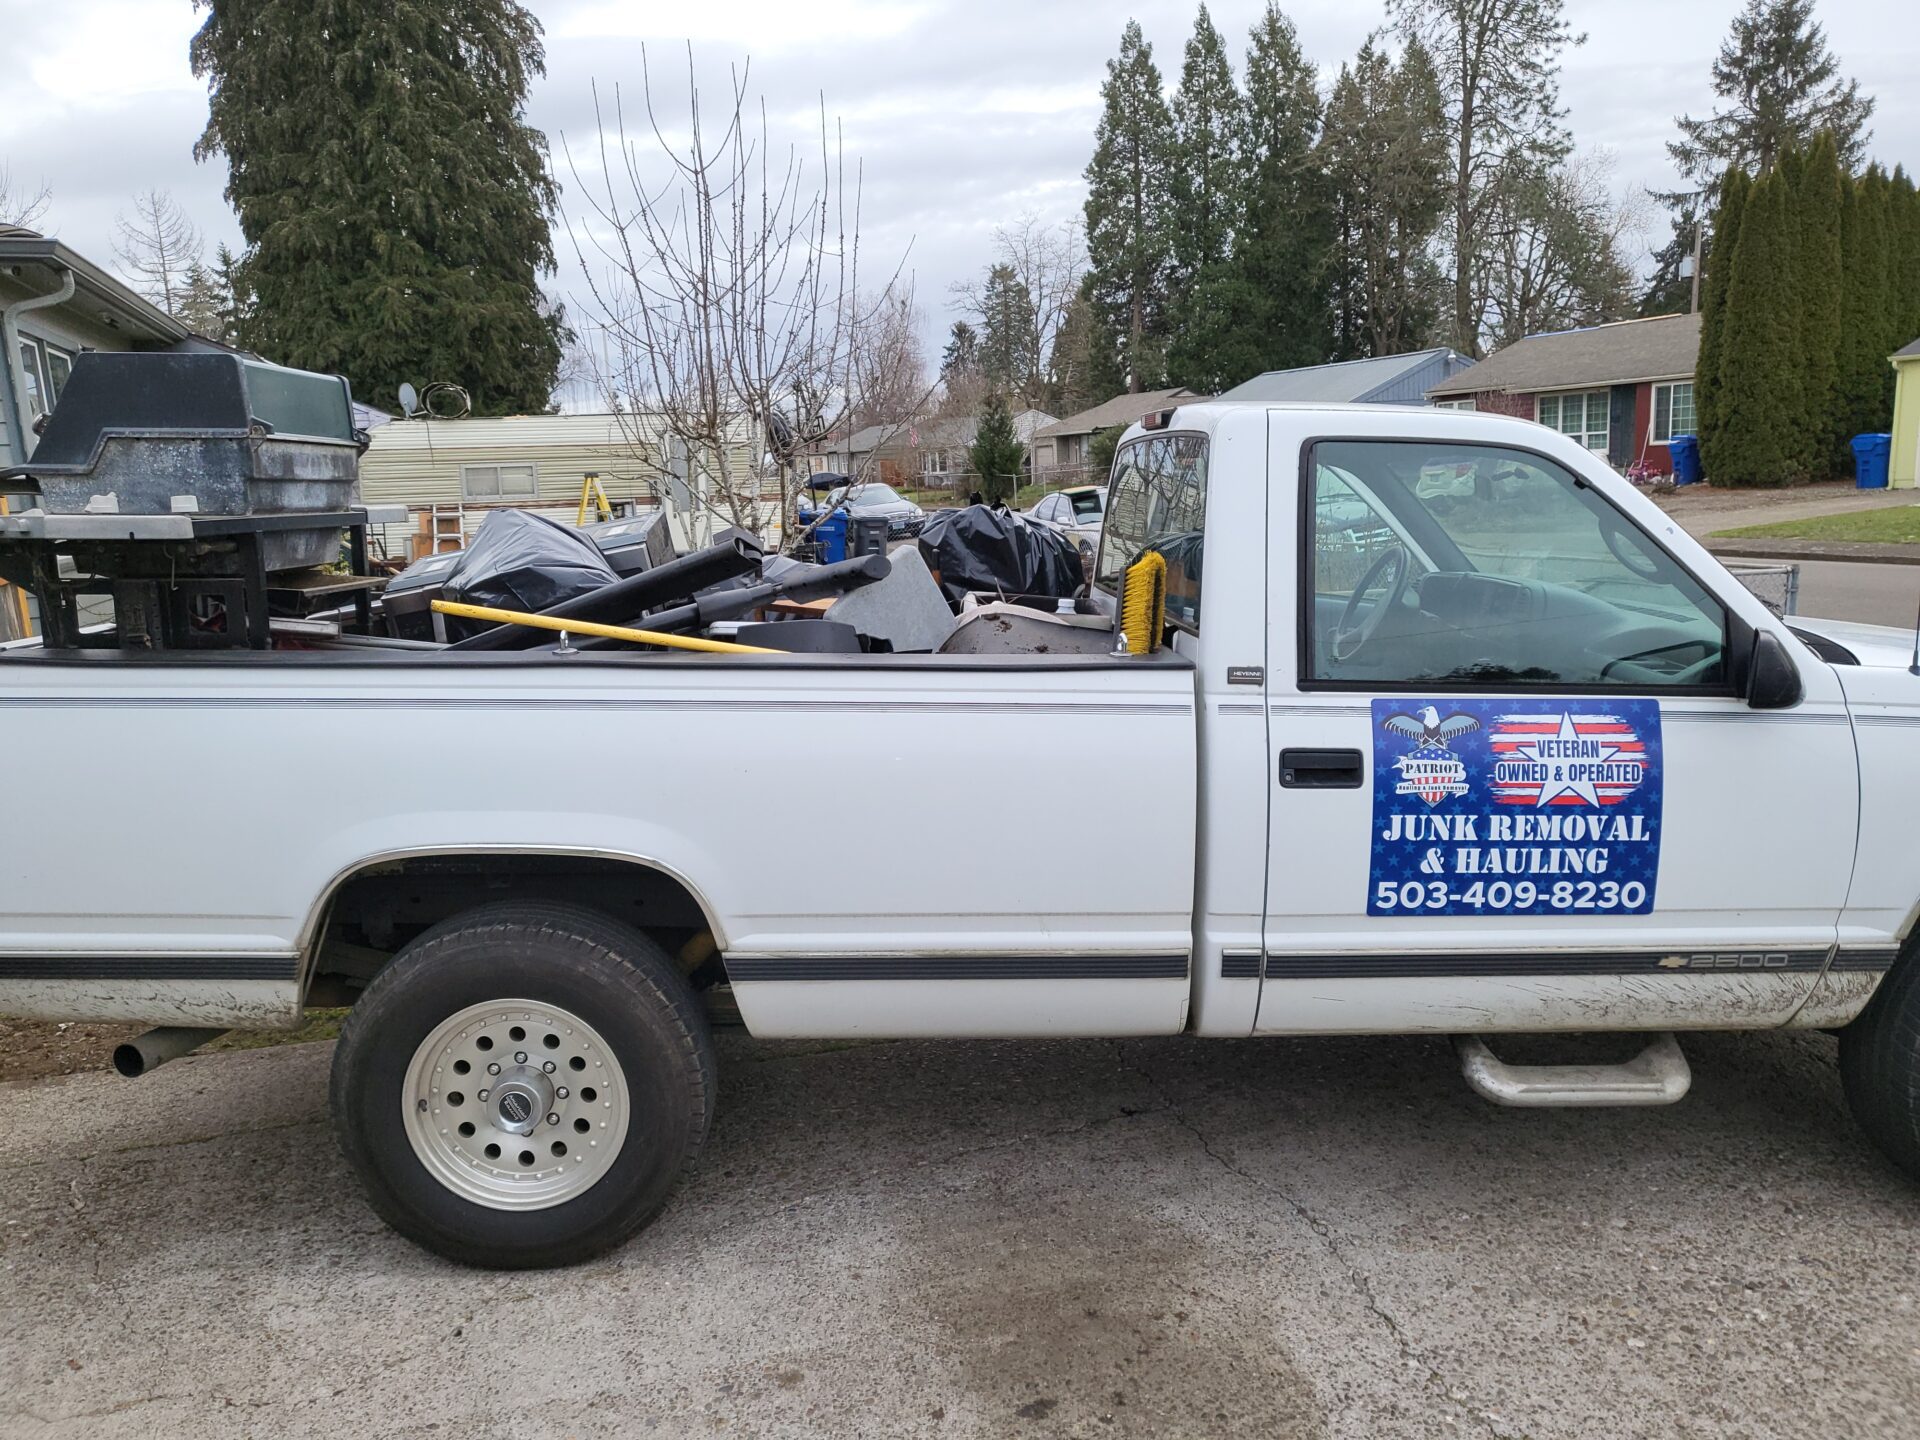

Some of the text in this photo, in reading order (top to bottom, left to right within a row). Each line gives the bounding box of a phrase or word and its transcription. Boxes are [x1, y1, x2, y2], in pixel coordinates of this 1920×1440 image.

[1536, 739, 1600, 759] VETERAN
[1405, 763, 1461, 773] PATRIOT
[1497, 763, 1641, 783] OWNED & OPERATED
[1383, 815, 1649, 841] JUNK REMOVAL
[1420, 847, 1609, 874] & HAULING
[1375, 881, 1646, 909] 503-409-8230
[1690, 954, 1788, 968] 2500
